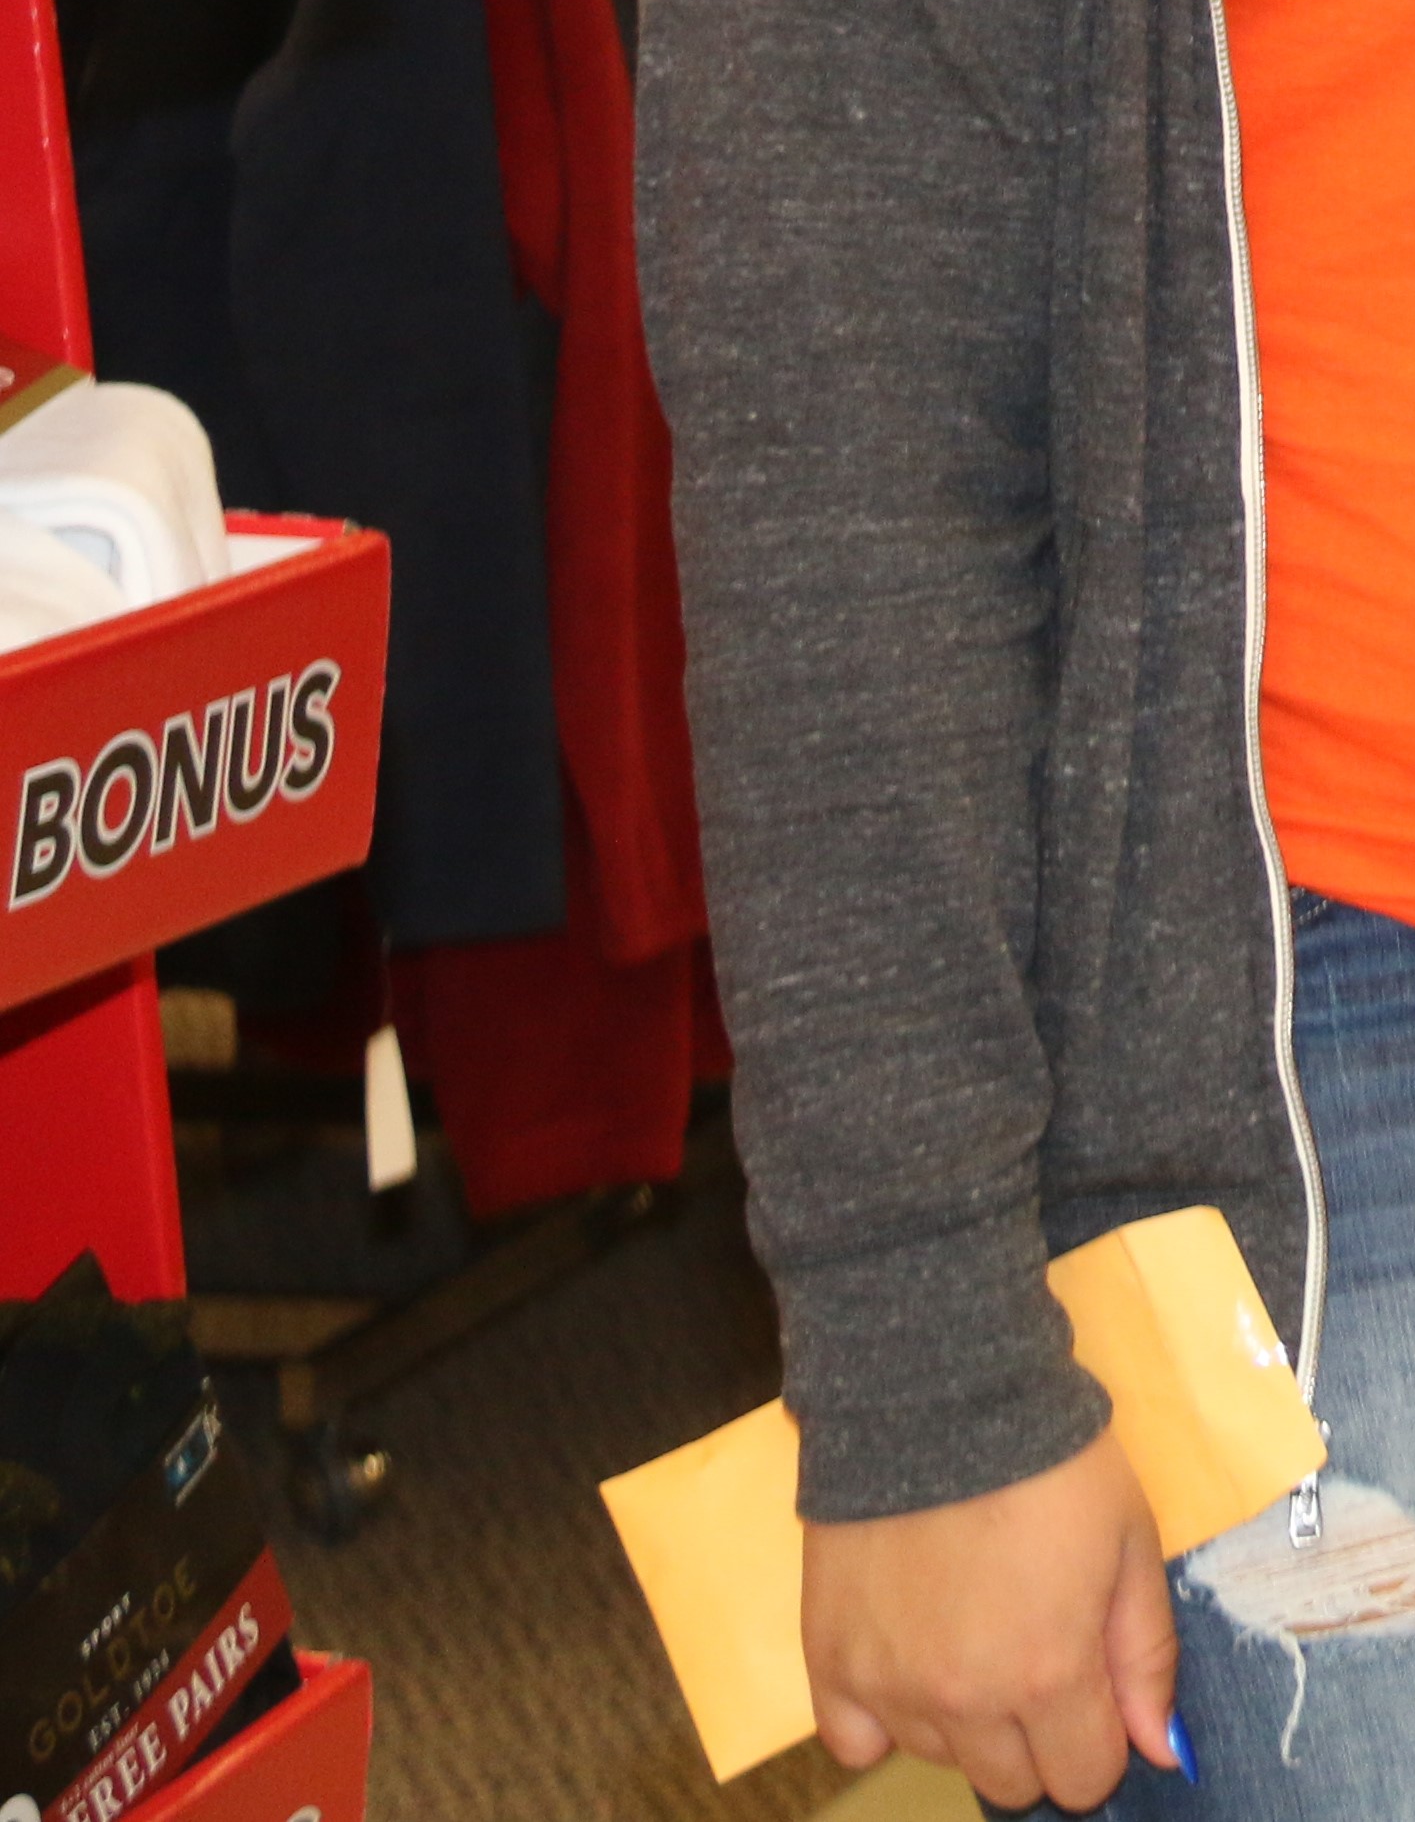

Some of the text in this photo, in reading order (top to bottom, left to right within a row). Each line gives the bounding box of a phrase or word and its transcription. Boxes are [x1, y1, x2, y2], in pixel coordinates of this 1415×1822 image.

[8, 658, 341, 913] BONUS
[79, 1591, 131, 1662] SPORT
[166, 1600, 261, 1742] PAIRS
